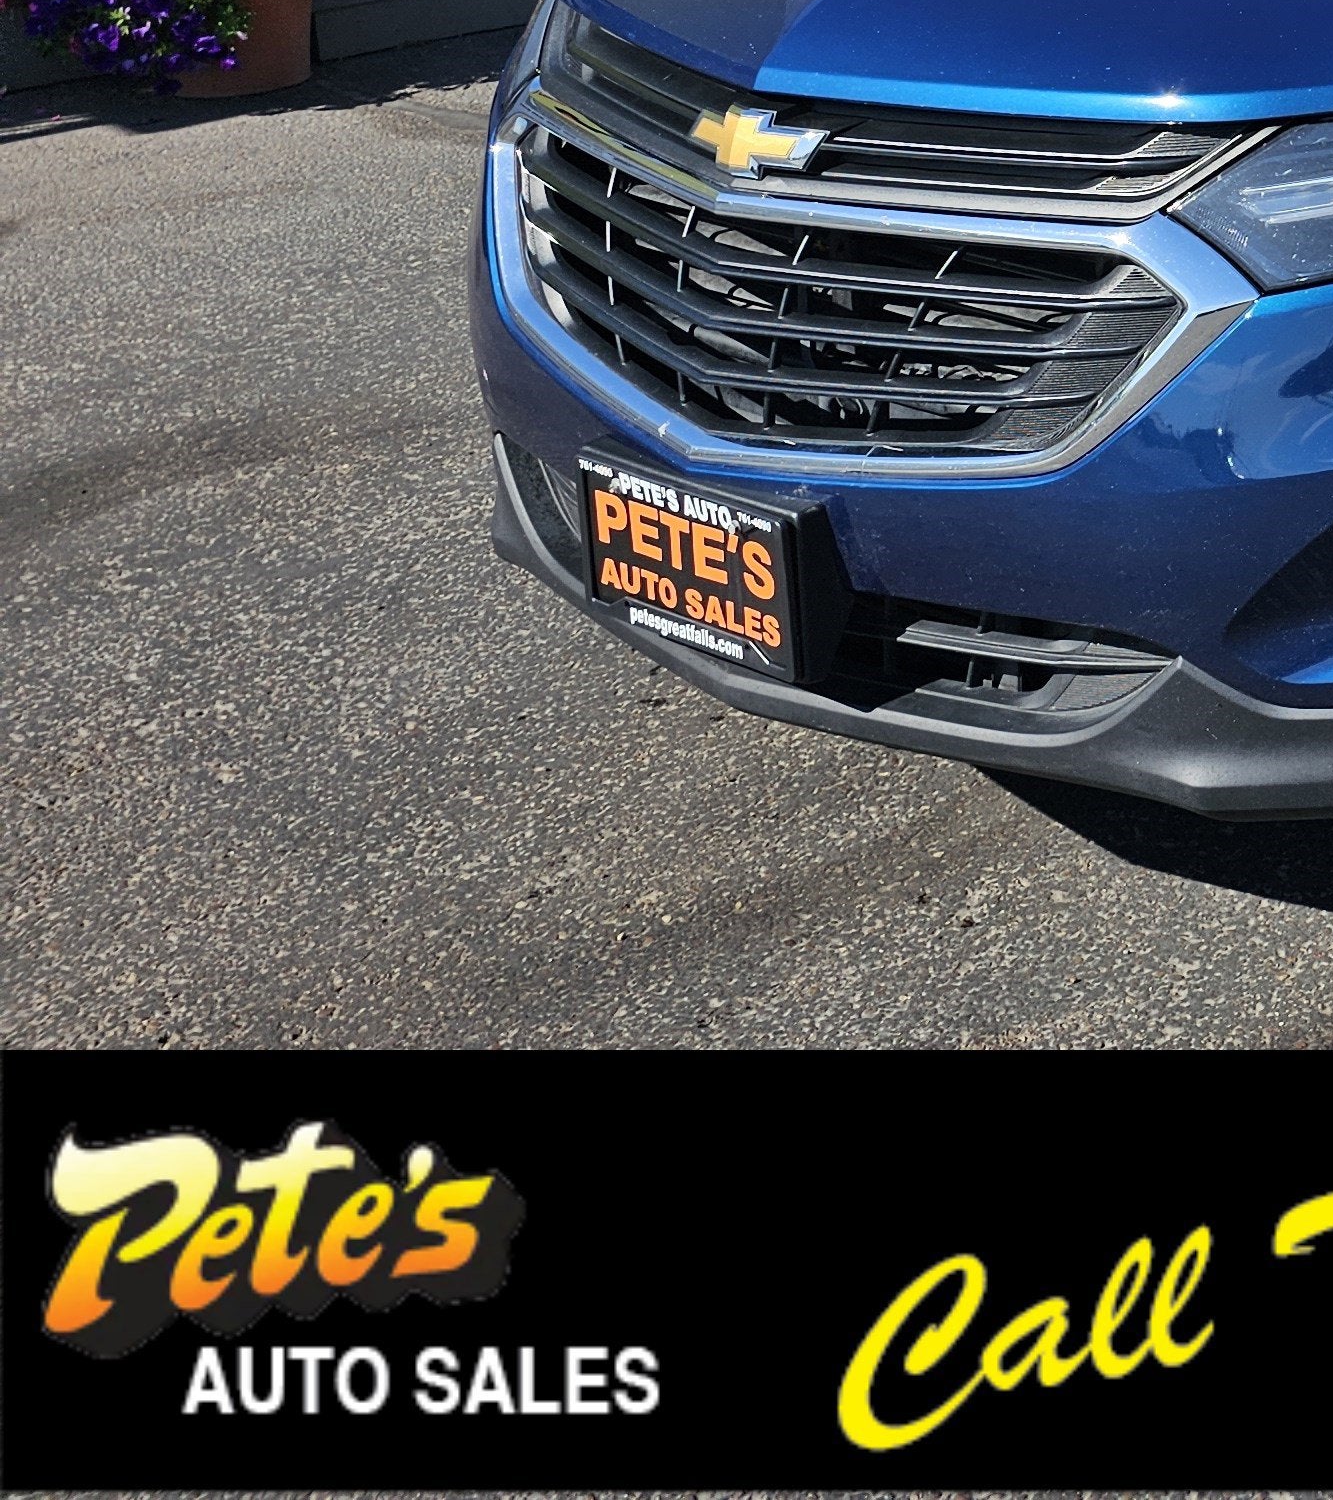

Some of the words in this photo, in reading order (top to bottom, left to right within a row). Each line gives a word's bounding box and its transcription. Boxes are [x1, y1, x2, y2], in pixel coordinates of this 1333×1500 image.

[618, 472, 680, 513] PETE'S
[683, 495, 732, 530] AUTO
[594, 490, 776, 600] PETE'S
[601, 557, 678, 609] AUTO
[684, 588, 781, 648] SALES
[629, 606, 744, 660] petesgreatfalls.com
